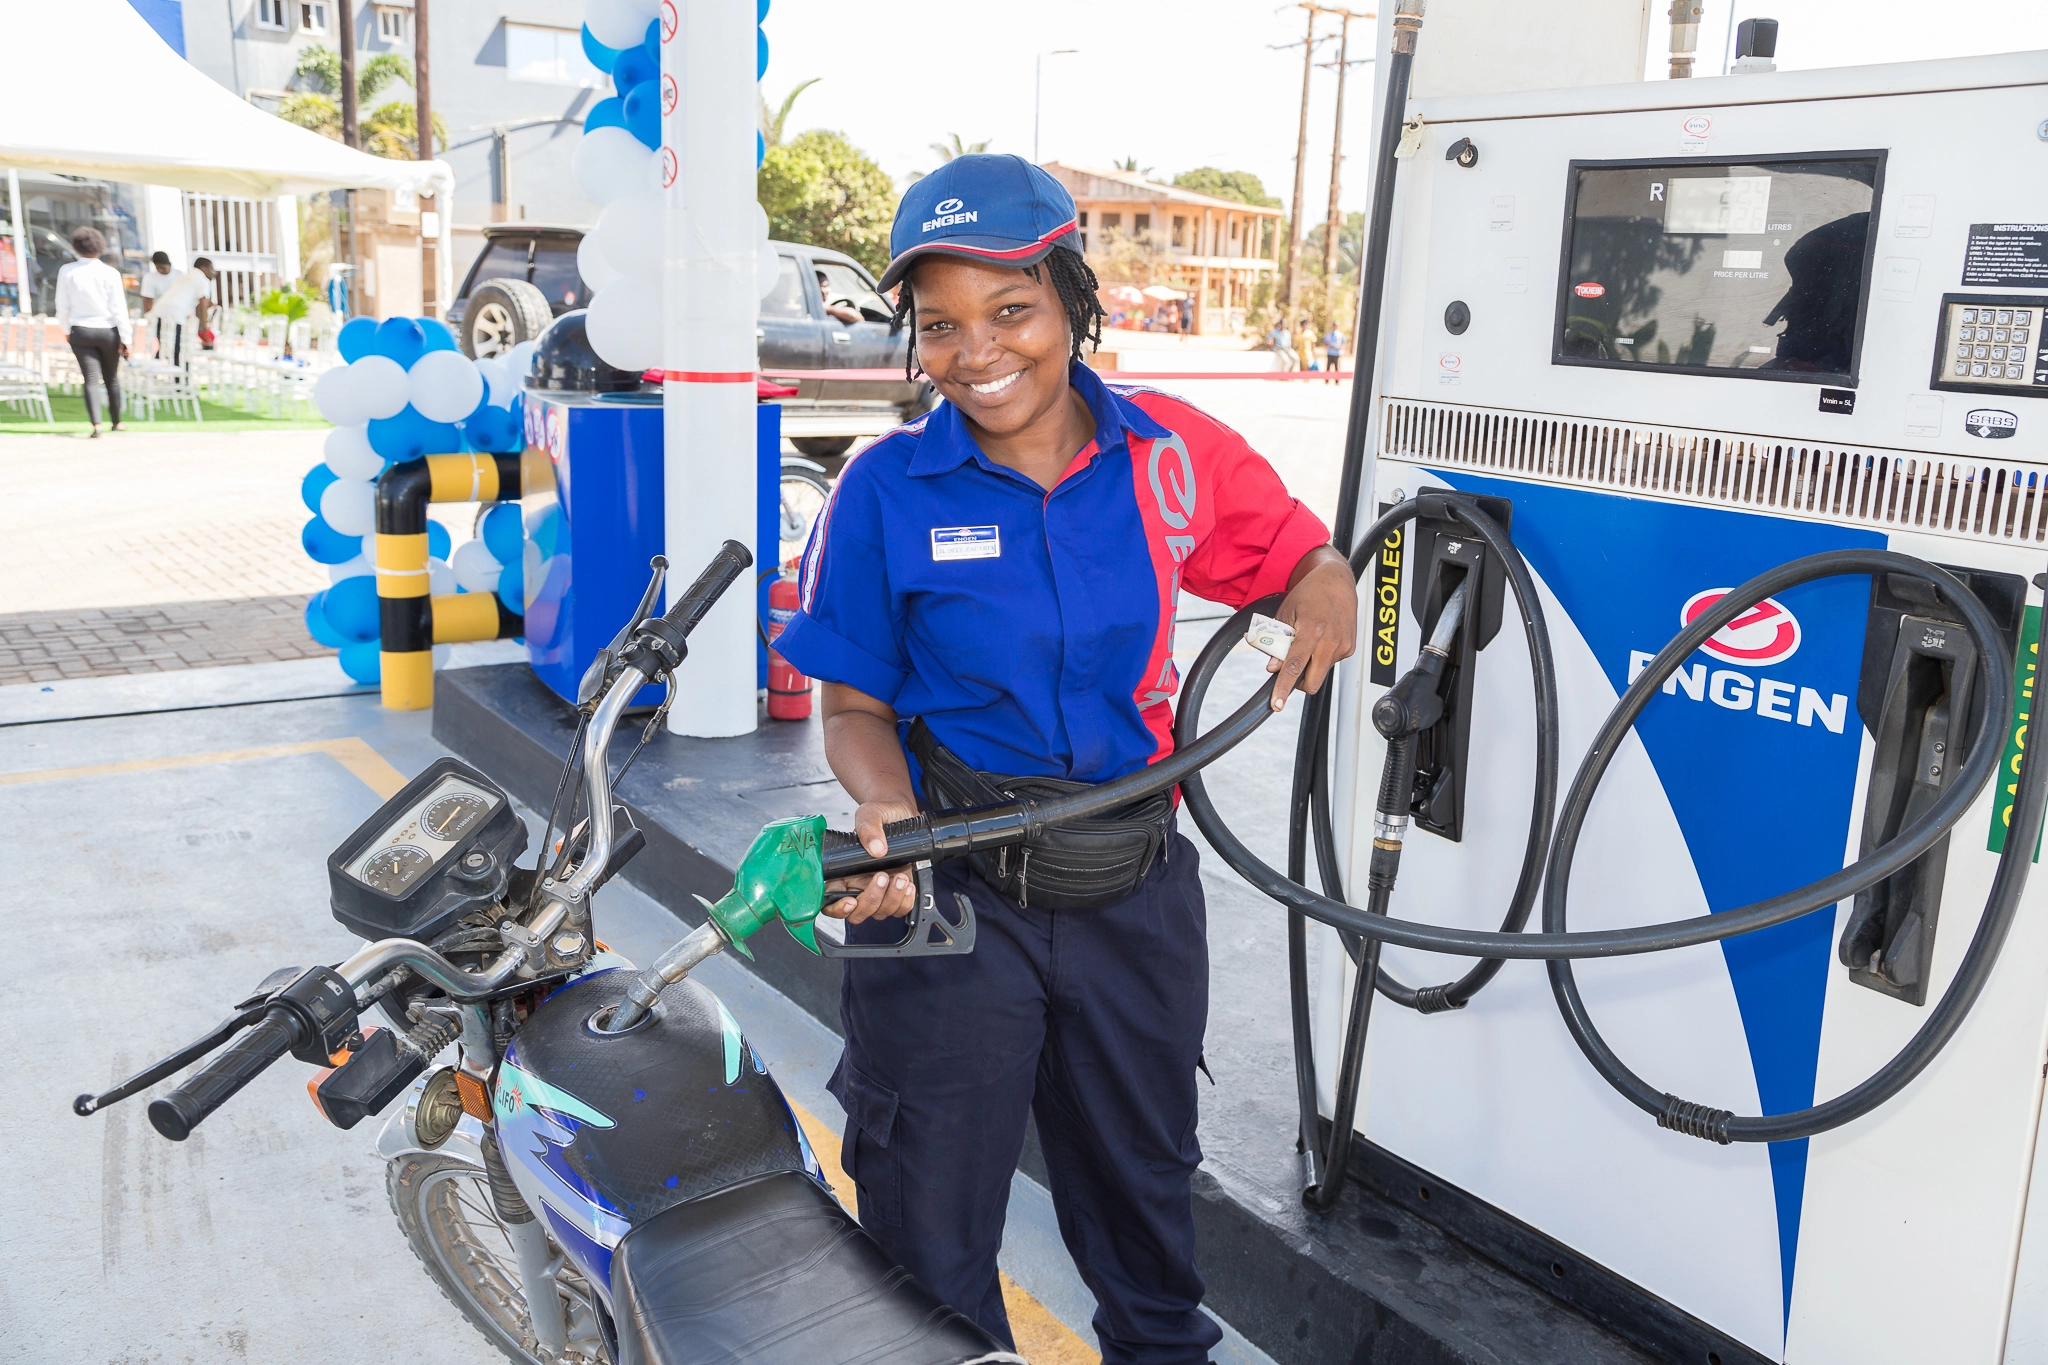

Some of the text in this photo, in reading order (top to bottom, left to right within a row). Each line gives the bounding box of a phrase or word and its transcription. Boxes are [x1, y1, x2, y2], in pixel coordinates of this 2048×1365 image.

[1650, 183, 1664, 201] R
[922, 210, 978, 233] ENGEN
[1767, 223, 1792, 231] LITRES
[1823, 397, 1838, 405] Vmin
[1969, 414, 2014, 426] SABS
[780, 827, 819, 859] ZVA
